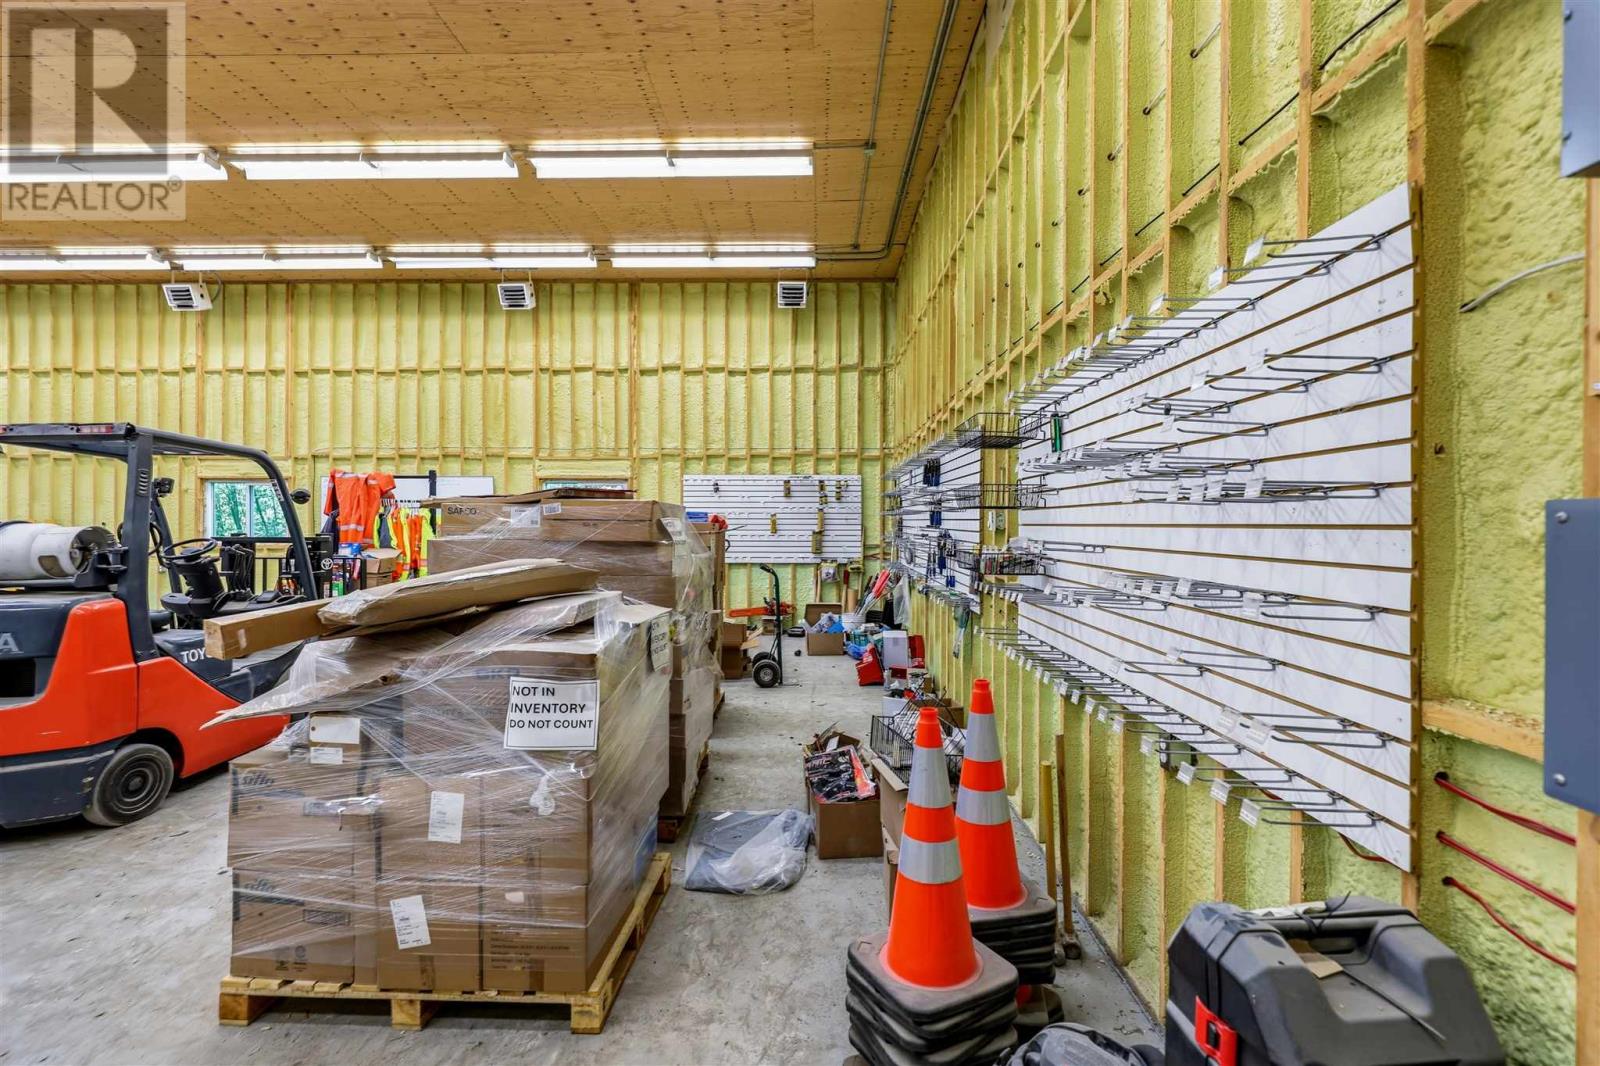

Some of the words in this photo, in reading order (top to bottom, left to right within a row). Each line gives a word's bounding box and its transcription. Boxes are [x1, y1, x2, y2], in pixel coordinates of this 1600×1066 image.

[180, 647, 212, 663] TOY
[512, 686, 539, 696] NOT
[541, 687, 555, 697] IN
[510, 703, 586, 713] INVENTORY
[509, 719, 525, 729] DO
[528, 719, 550, 729] NOT
[553, 719, 593, 729] COUNT
